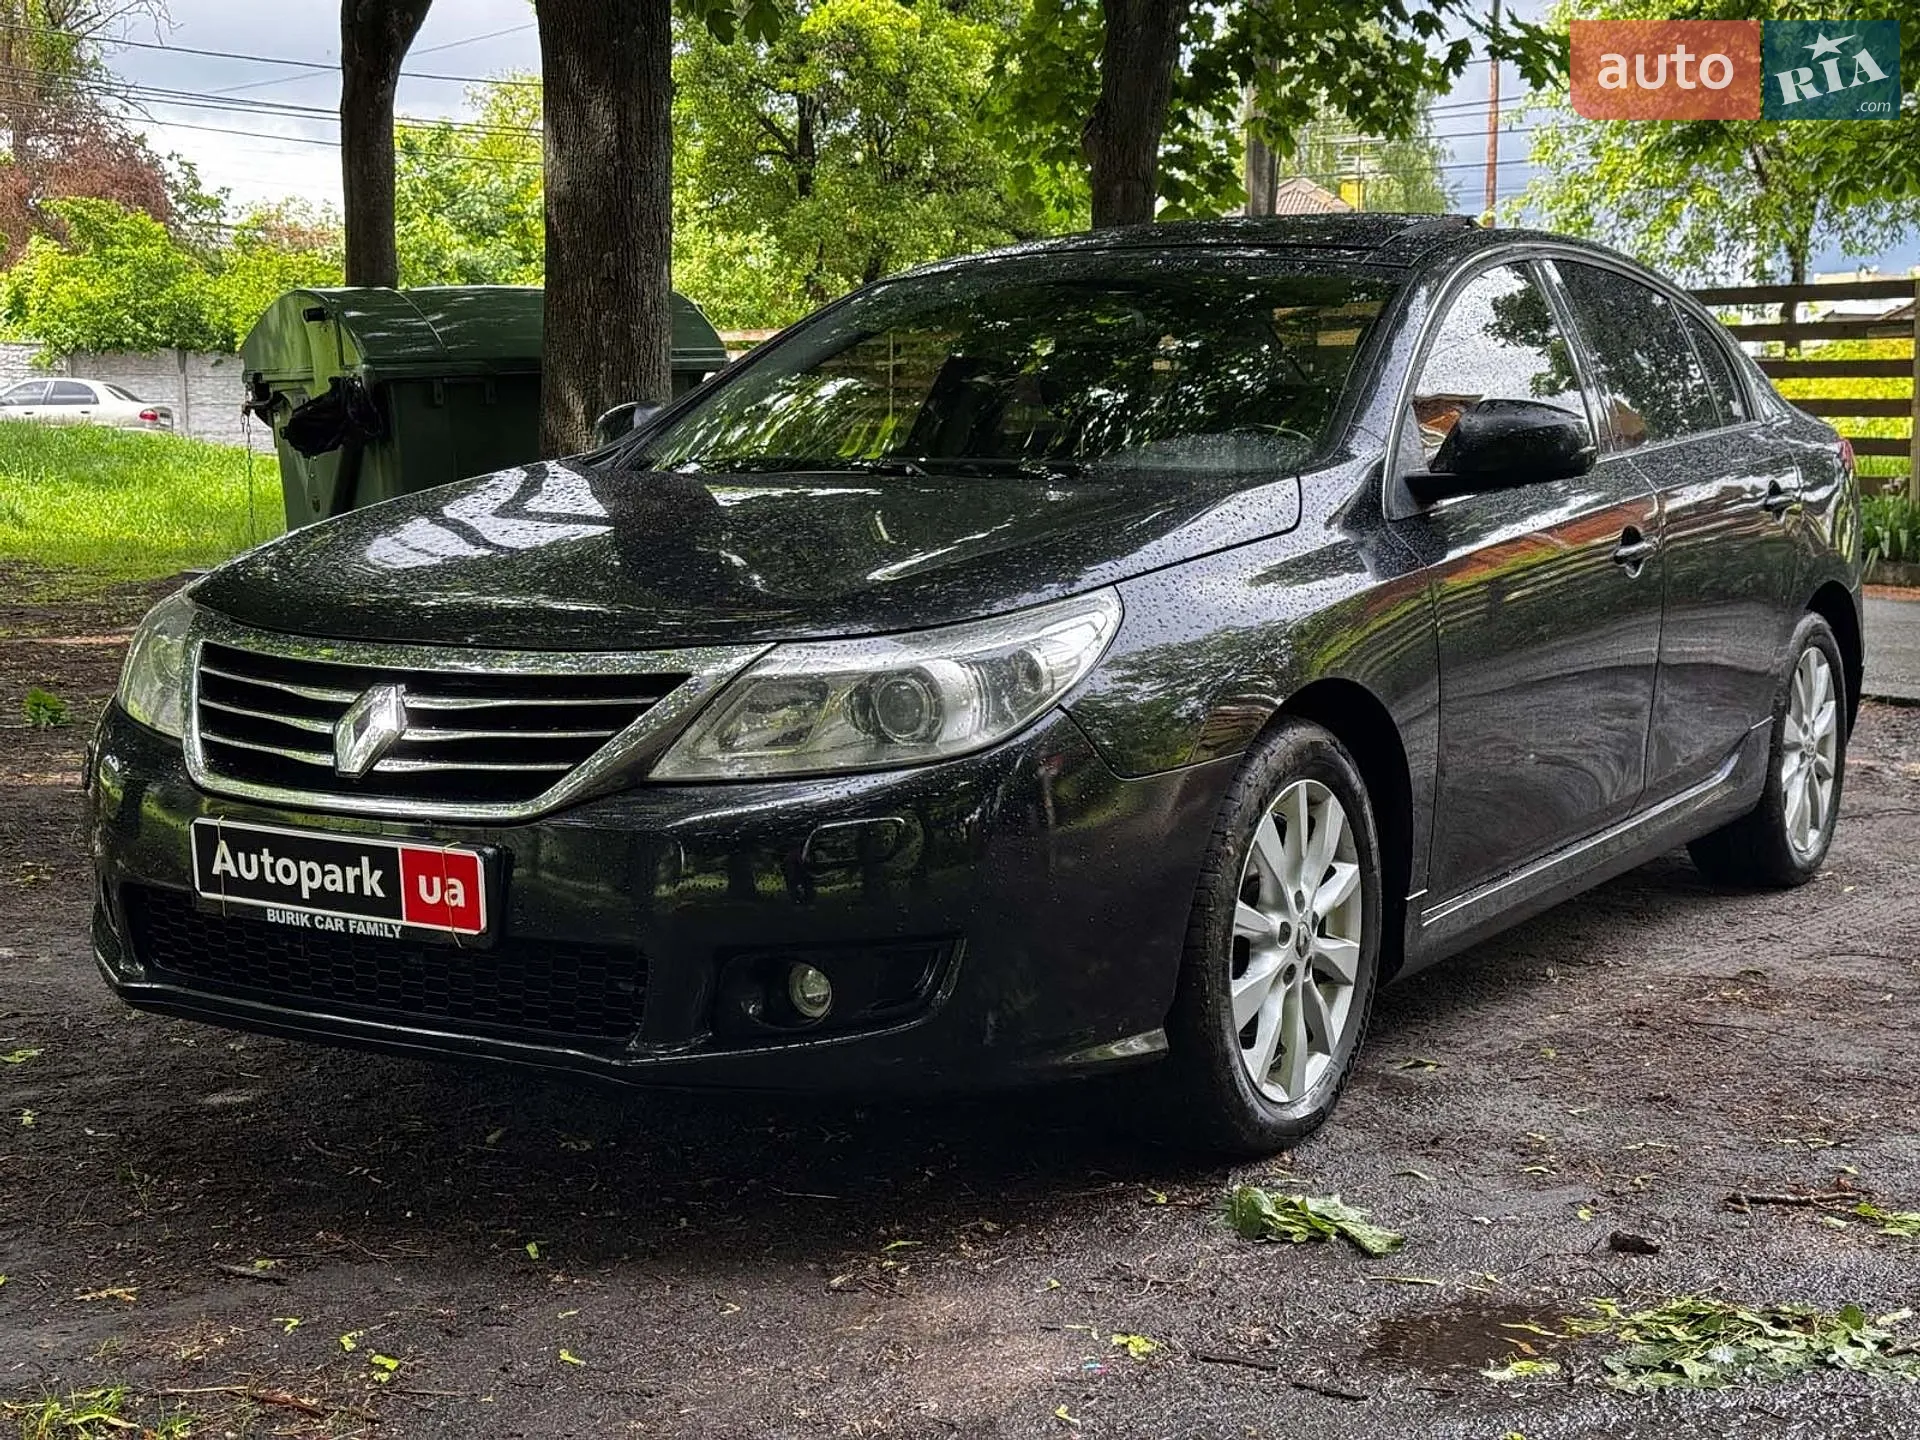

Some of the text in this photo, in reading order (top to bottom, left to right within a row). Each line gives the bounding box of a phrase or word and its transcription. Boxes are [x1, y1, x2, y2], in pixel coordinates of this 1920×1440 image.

[211, 839, 386, 899] Autopark
[418, 873, 466, 908] ua
[314, 915, 346, 933] CAR
